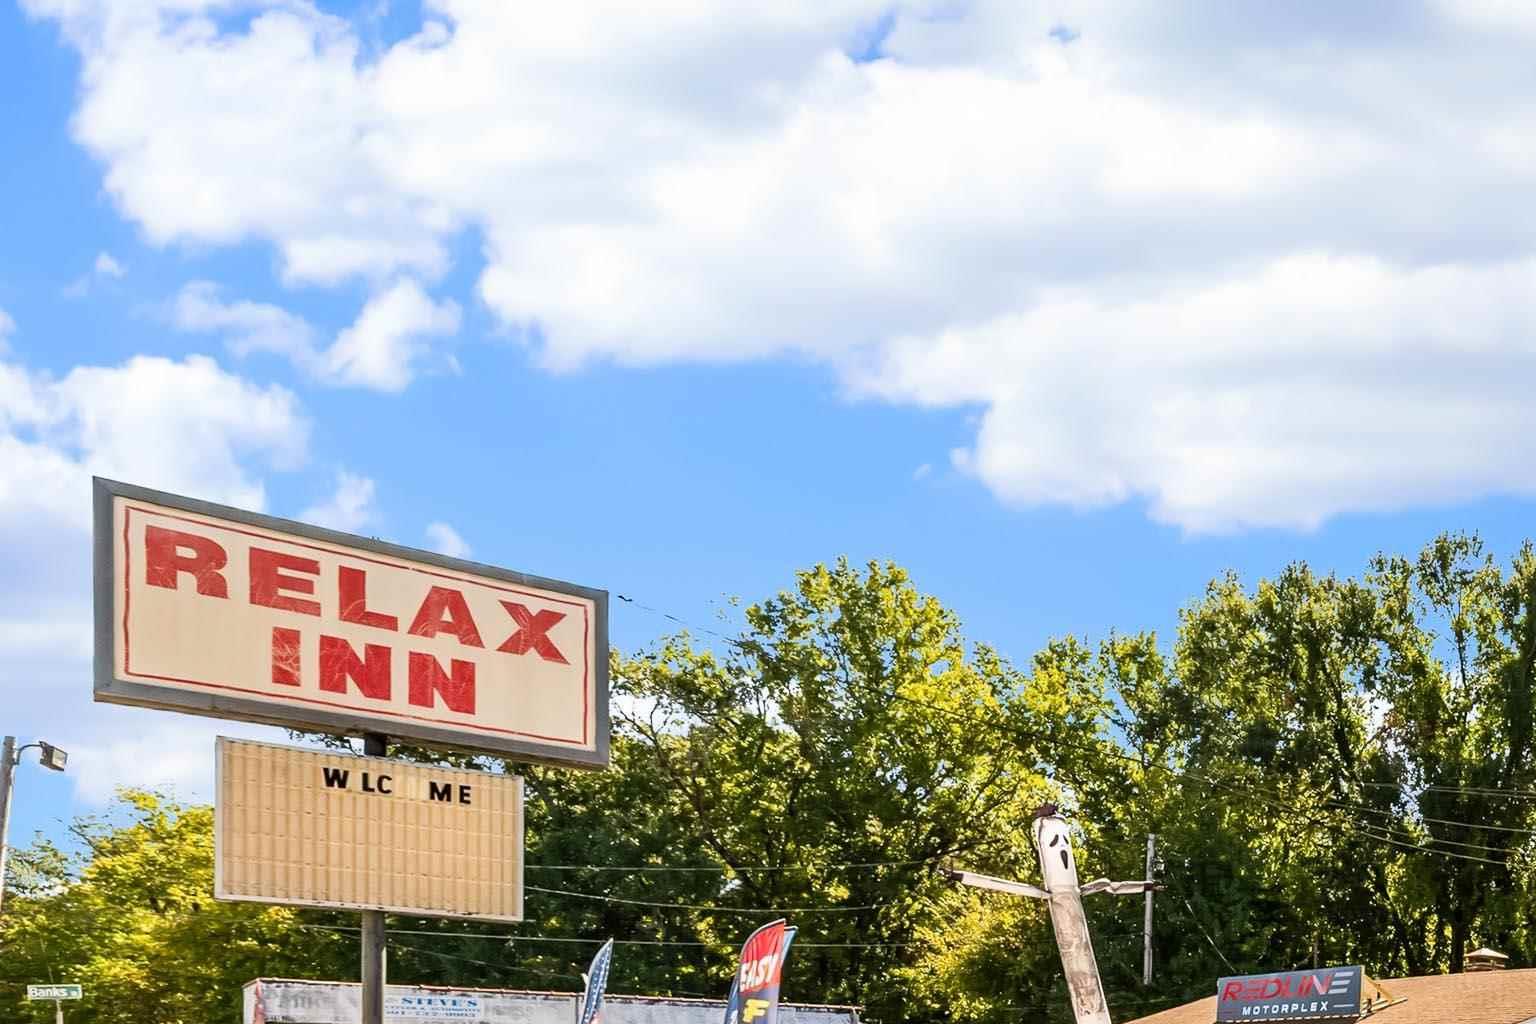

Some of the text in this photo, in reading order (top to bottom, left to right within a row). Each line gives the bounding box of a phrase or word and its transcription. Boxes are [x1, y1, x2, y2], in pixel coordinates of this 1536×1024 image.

[144, 524, 571, 665] RELAX
[271, 626, 477, 715] INN
[739, 953, 778, 993] EASY
[1222, 971, 1354, 1002] REDLINE
[30, 987, 68, 997] Banks
[1242, 1001, 1329, 1016] MOTORPLEX
